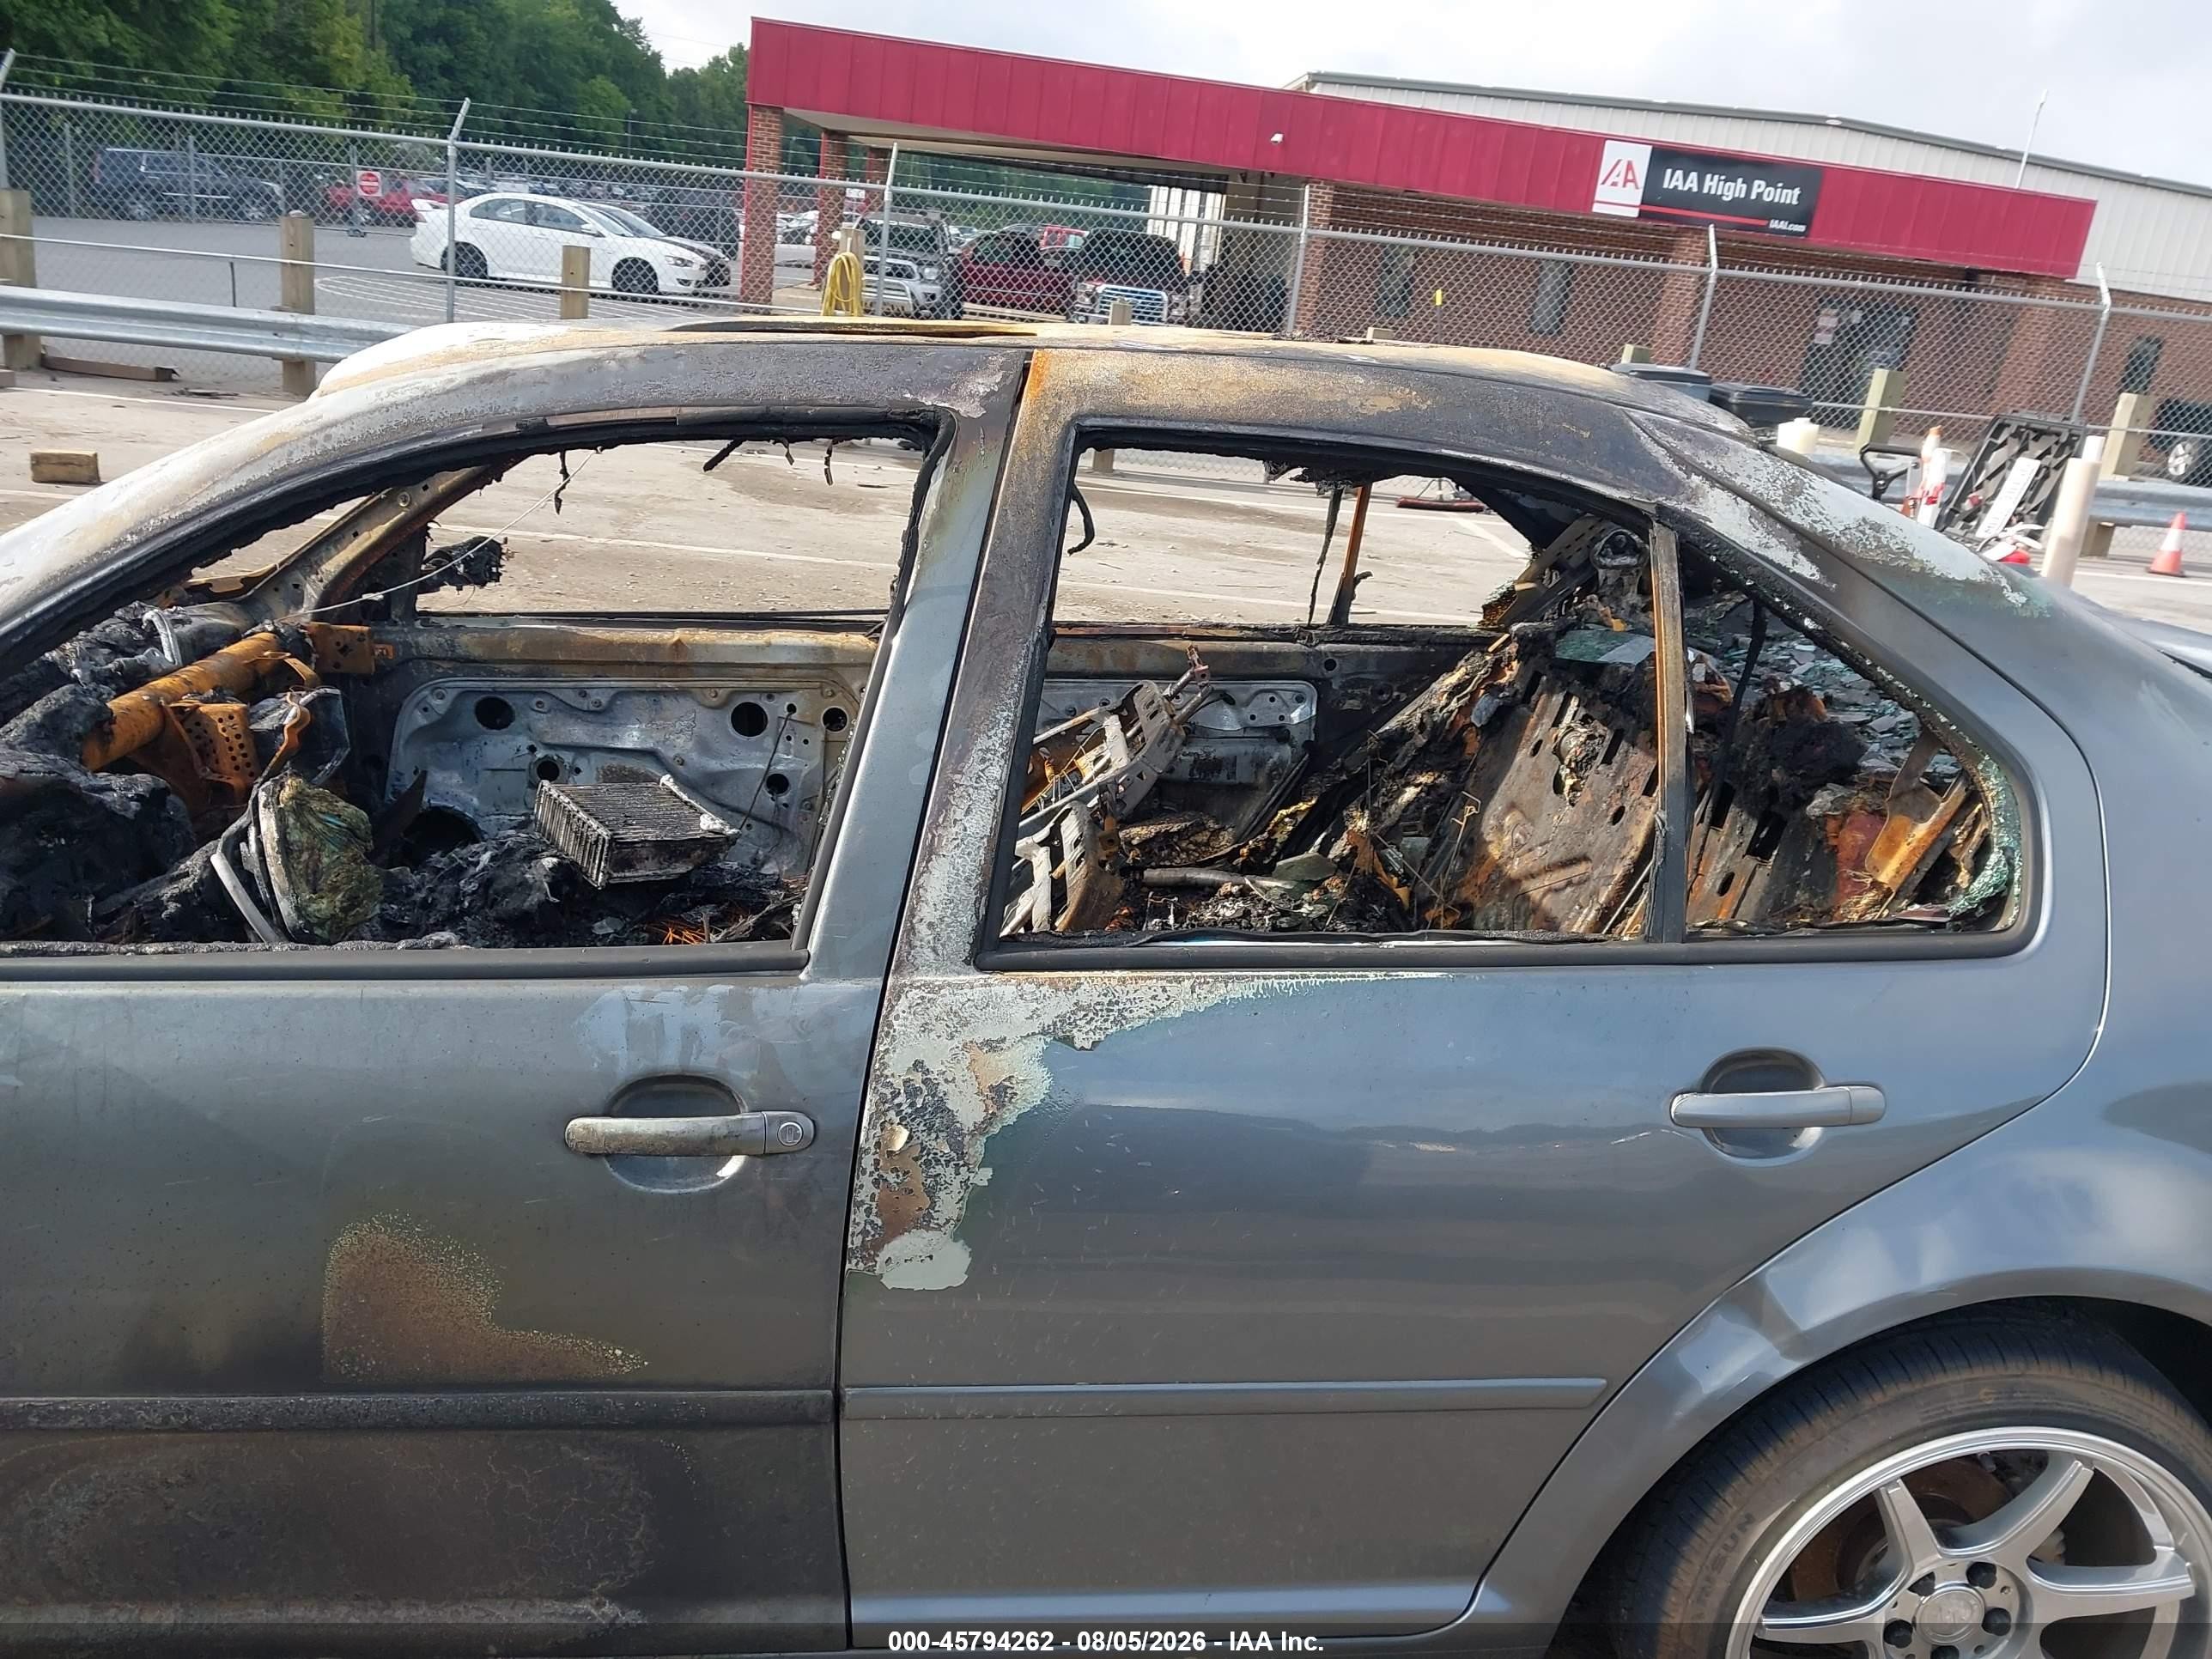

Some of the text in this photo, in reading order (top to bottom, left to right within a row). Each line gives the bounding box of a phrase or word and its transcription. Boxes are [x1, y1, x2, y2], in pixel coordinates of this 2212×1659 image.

[1662, 168, 1802, 205] IAA High Point
